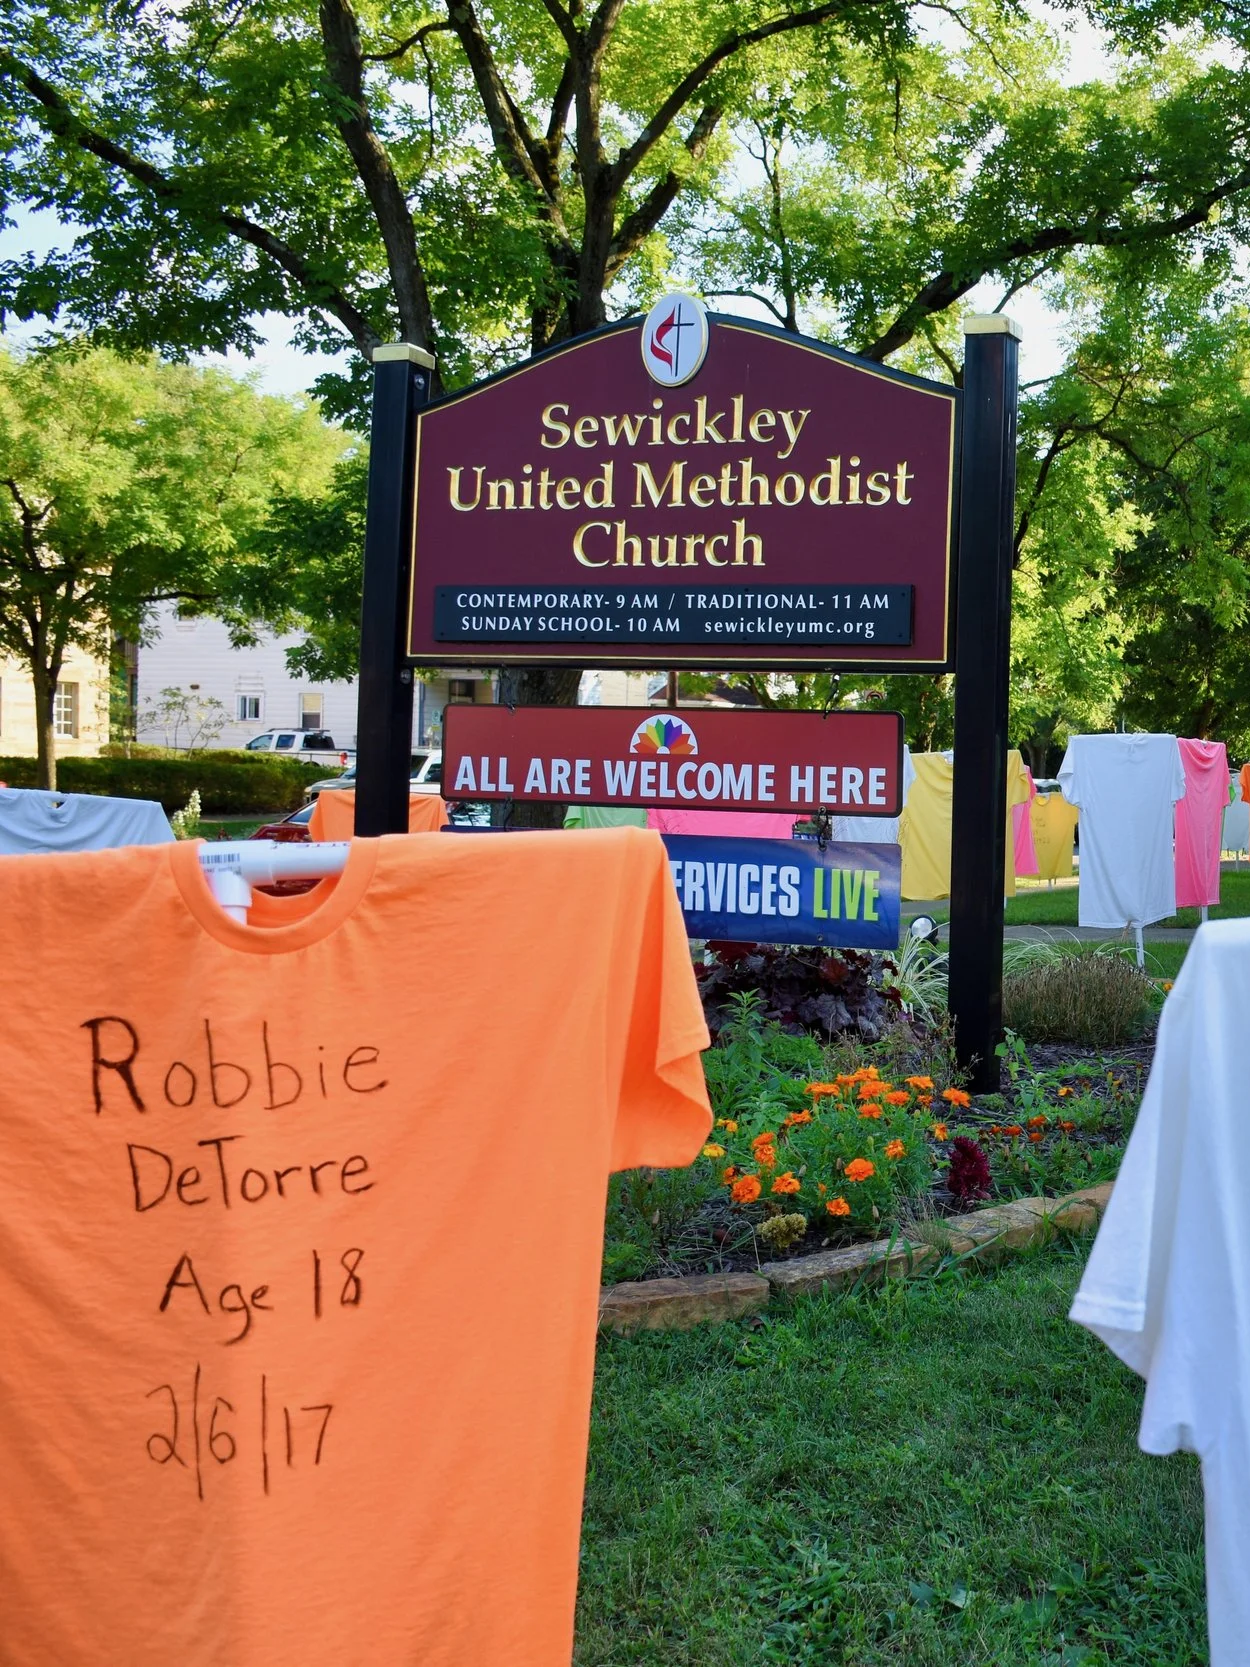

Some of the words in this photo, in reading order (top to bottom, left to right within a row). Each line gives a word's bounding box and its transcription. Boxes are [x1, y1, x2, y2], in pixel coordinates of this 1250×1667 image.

[540, 393, 811, 459] Sewickley
[446, 460, 616, 511] United
[631, 455, 914, 508] Methodist
[572, 517, 766, 568] Church
[456, 593, 610, 609] CONTEMPORARY-
[616, 594, 625, 609] 9
[631, 594, 658, 609] AM
[685, 593, 825, 609] TRADITIONAL-
[832, 594, 851, 609] 11
[859, 593, 890, 609] AM
[461, 616, 533, 631] SUNDAY
[538, 616, 620, 632] SCHOOL-
[627, 617, 647, 632] 10
[653, 617, 680, 632] AM
[704, 617, 875, 639] sewickleyumc.org
[454, 755, 514, 793] ALL
[523, 758, 591, 795] ARE
[603, 759, 775, 801] WELCOME
[790, 765, 887, 805] HERE
[668, 860, 801, 917] ERVICES
[813, 867, 880, 921] LIVE
[80, 1015, 389, 1114] Robbie
[127, 1134, 378, 1213] DeTorre
[158, 1253, 275, 1346] Age
[312, 1248, 365, 1319] 18
